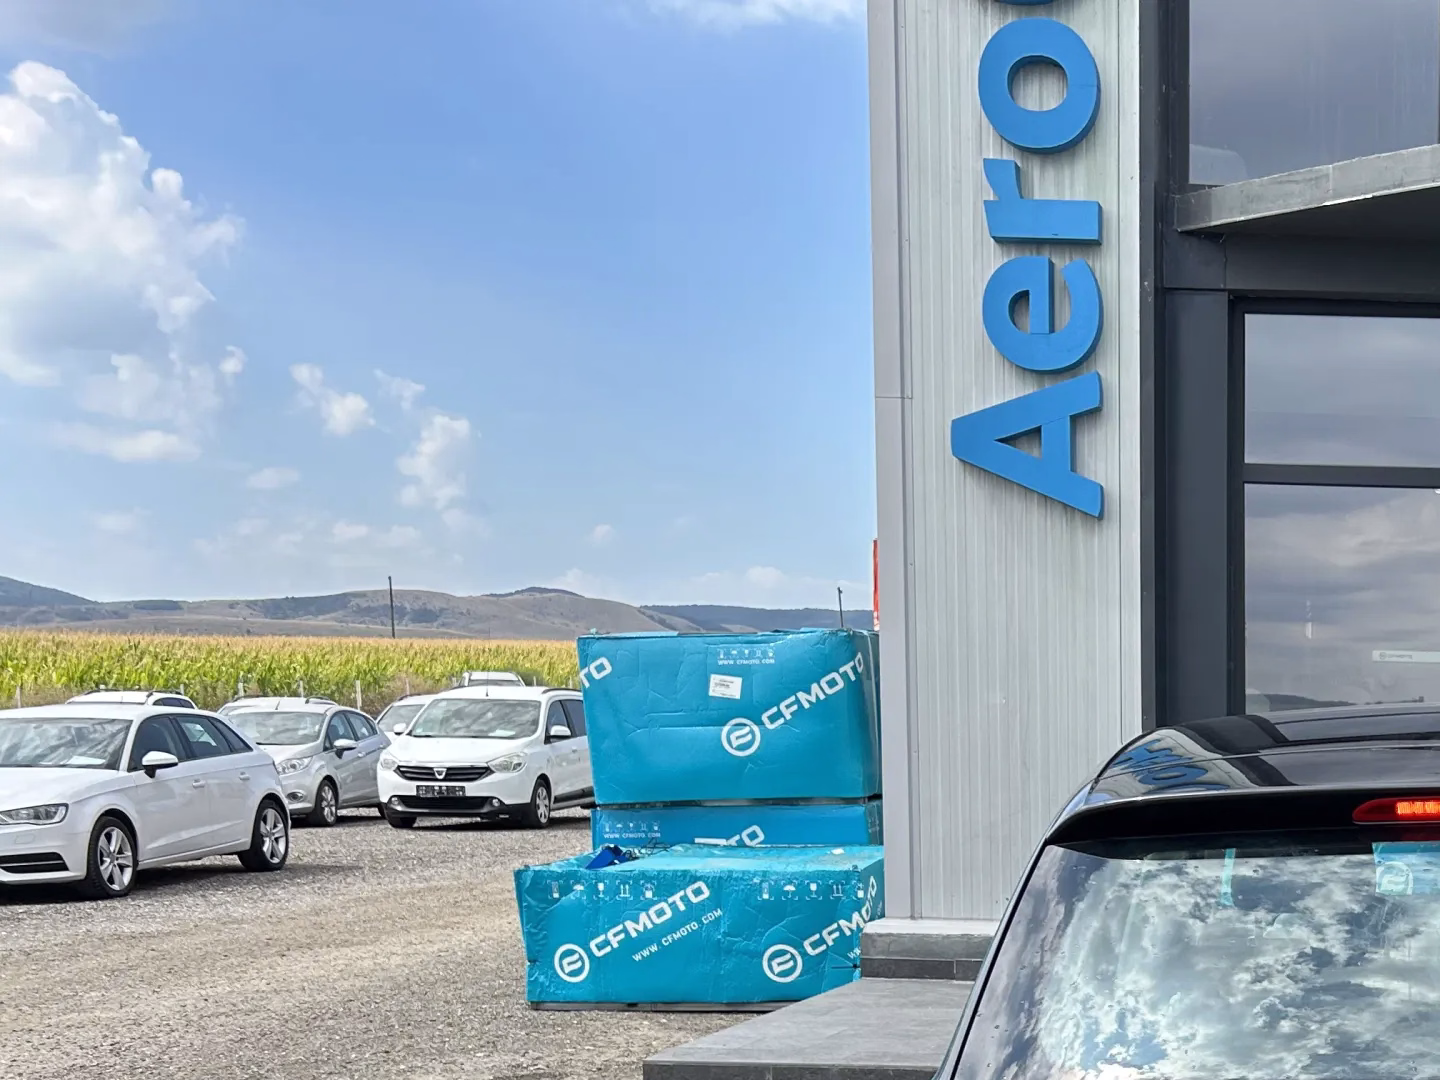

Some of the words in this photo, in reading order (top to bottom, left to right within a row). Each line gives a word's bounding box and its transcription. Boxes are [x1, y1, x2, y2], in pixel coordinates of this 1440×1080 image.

[951, 0, 1104, 520] Aero
[761, 652, 864, 730] CFMOTO
[589, 880, 711, 958] CFMOTO
